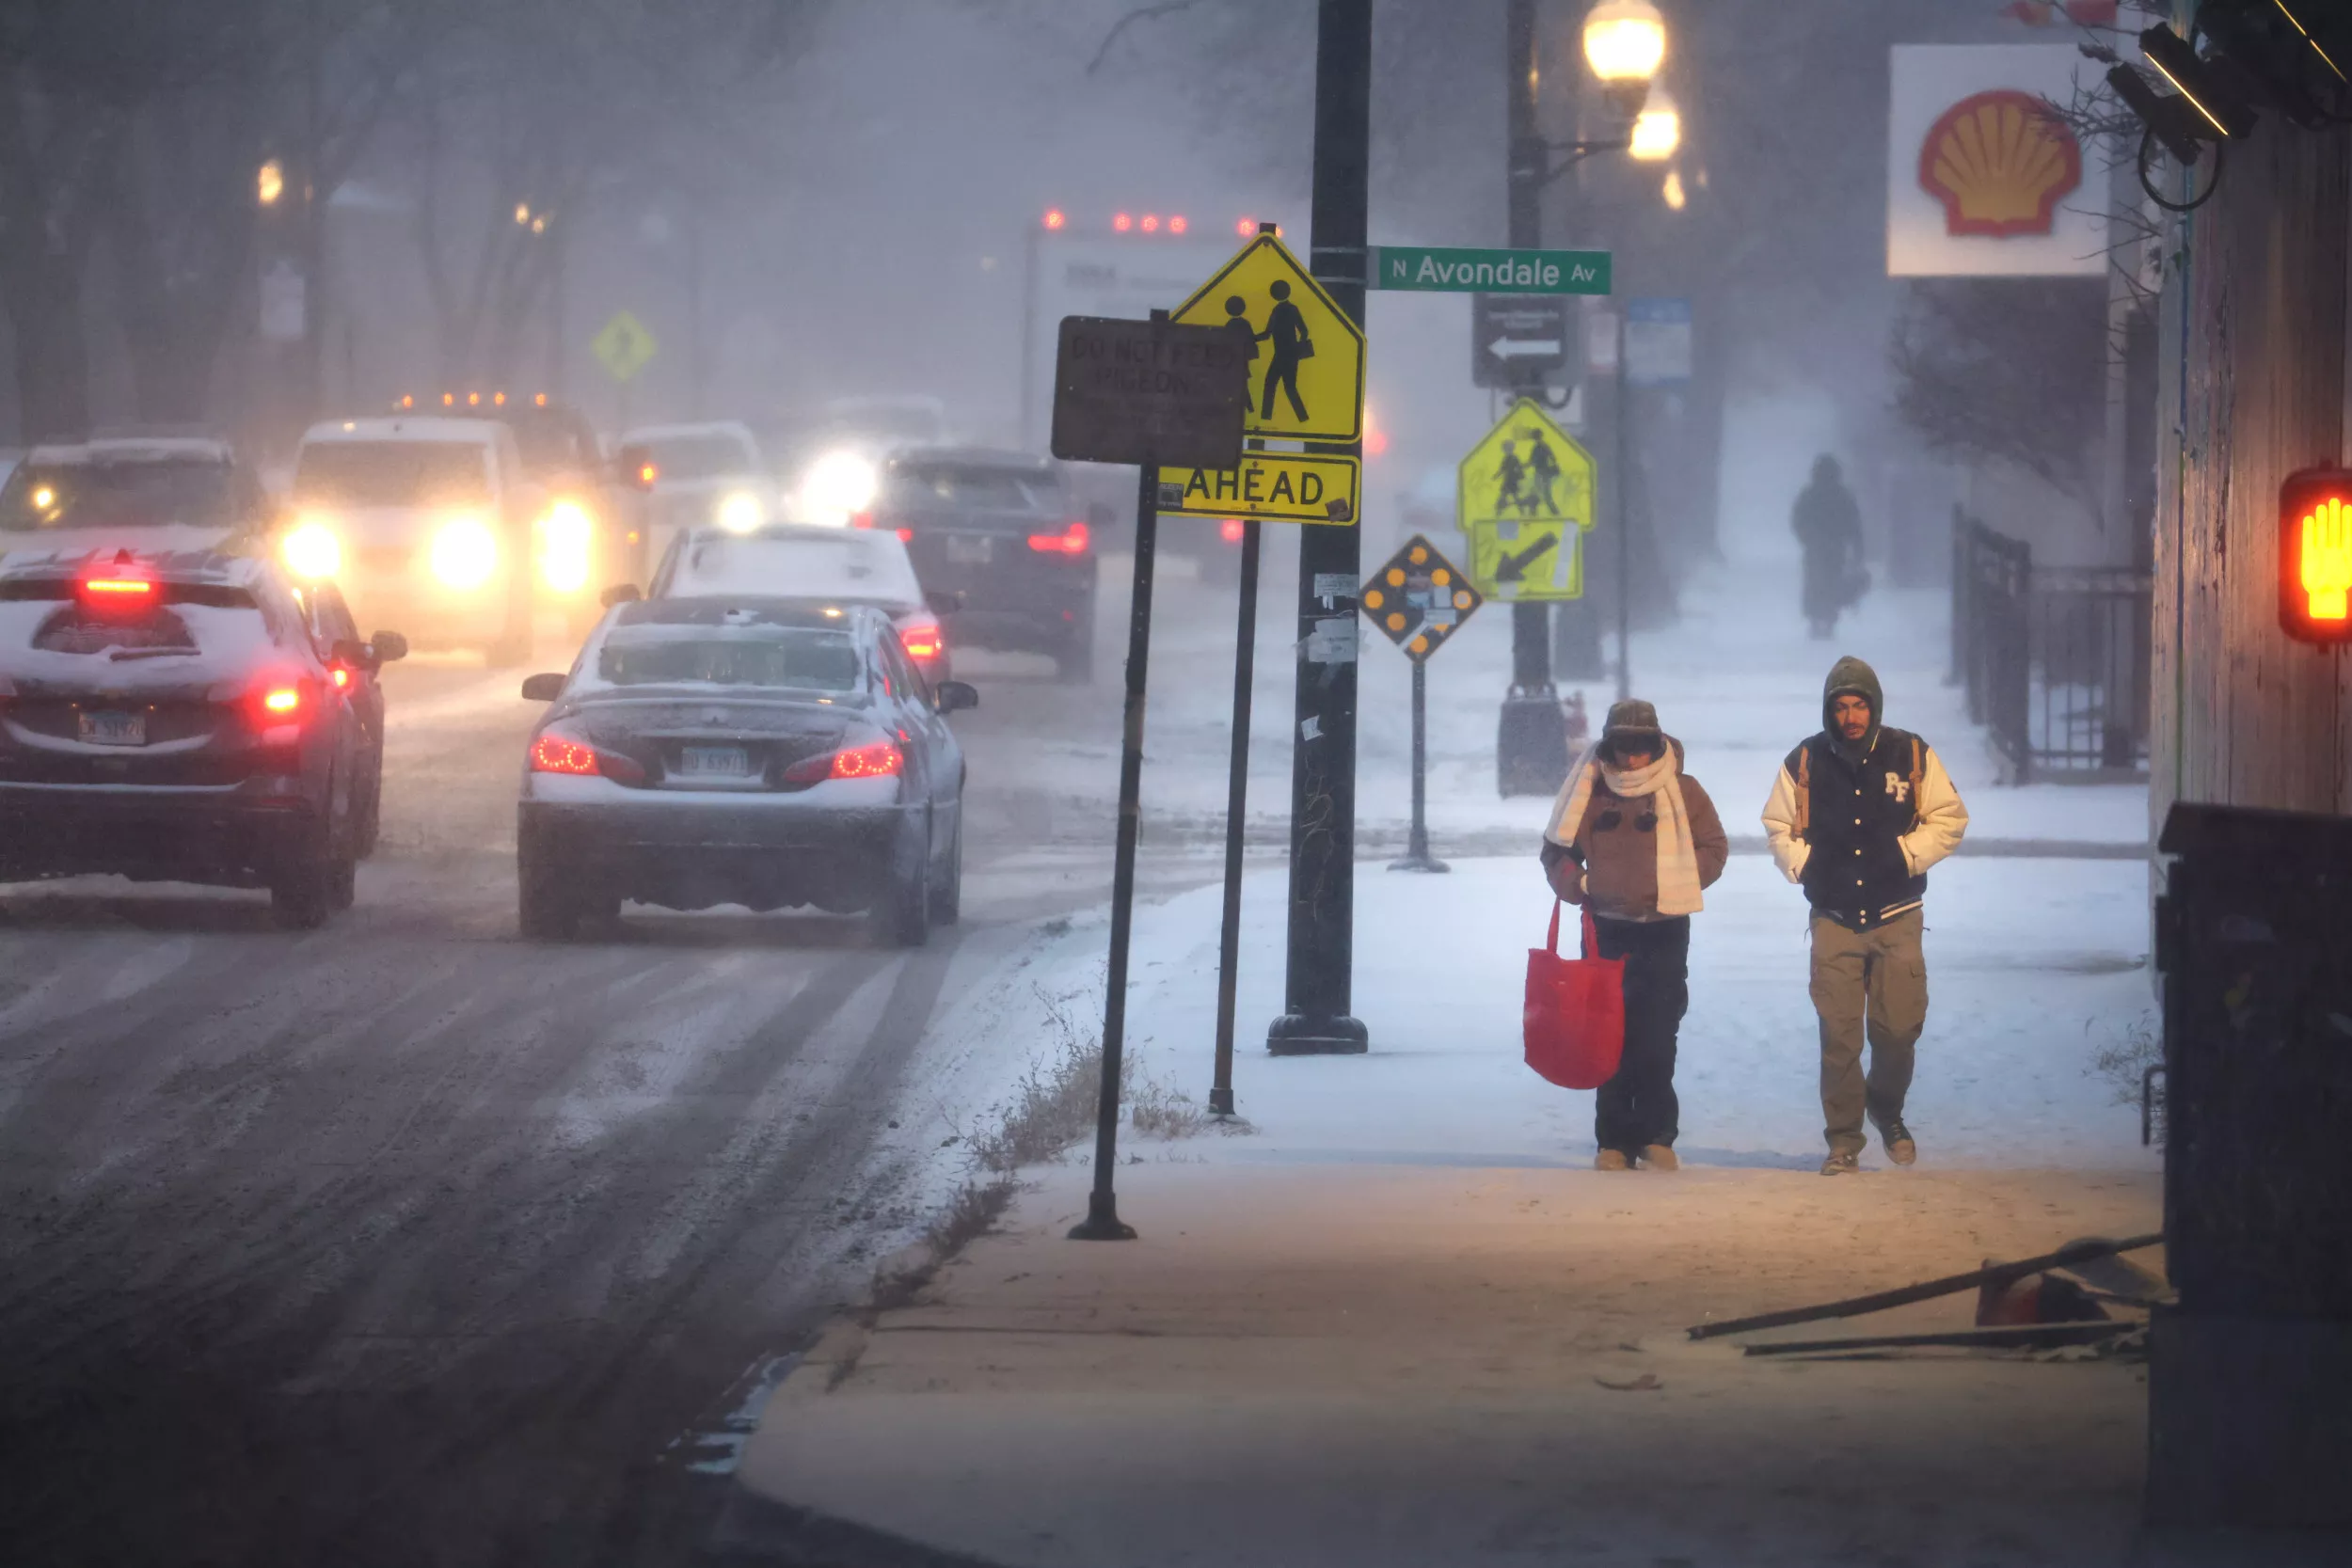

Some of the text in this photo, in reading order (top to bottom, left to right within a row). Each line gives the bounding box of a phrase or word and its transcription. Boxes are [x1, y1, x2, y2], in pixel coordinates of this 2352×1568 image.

[1392, 256, 1597, 285] N Avondale Av
[1072, 336, 1104, 359] DO
[1115, 338, 1162, 364] NOT
[1184, 468, 1323, 505] AHEAD
